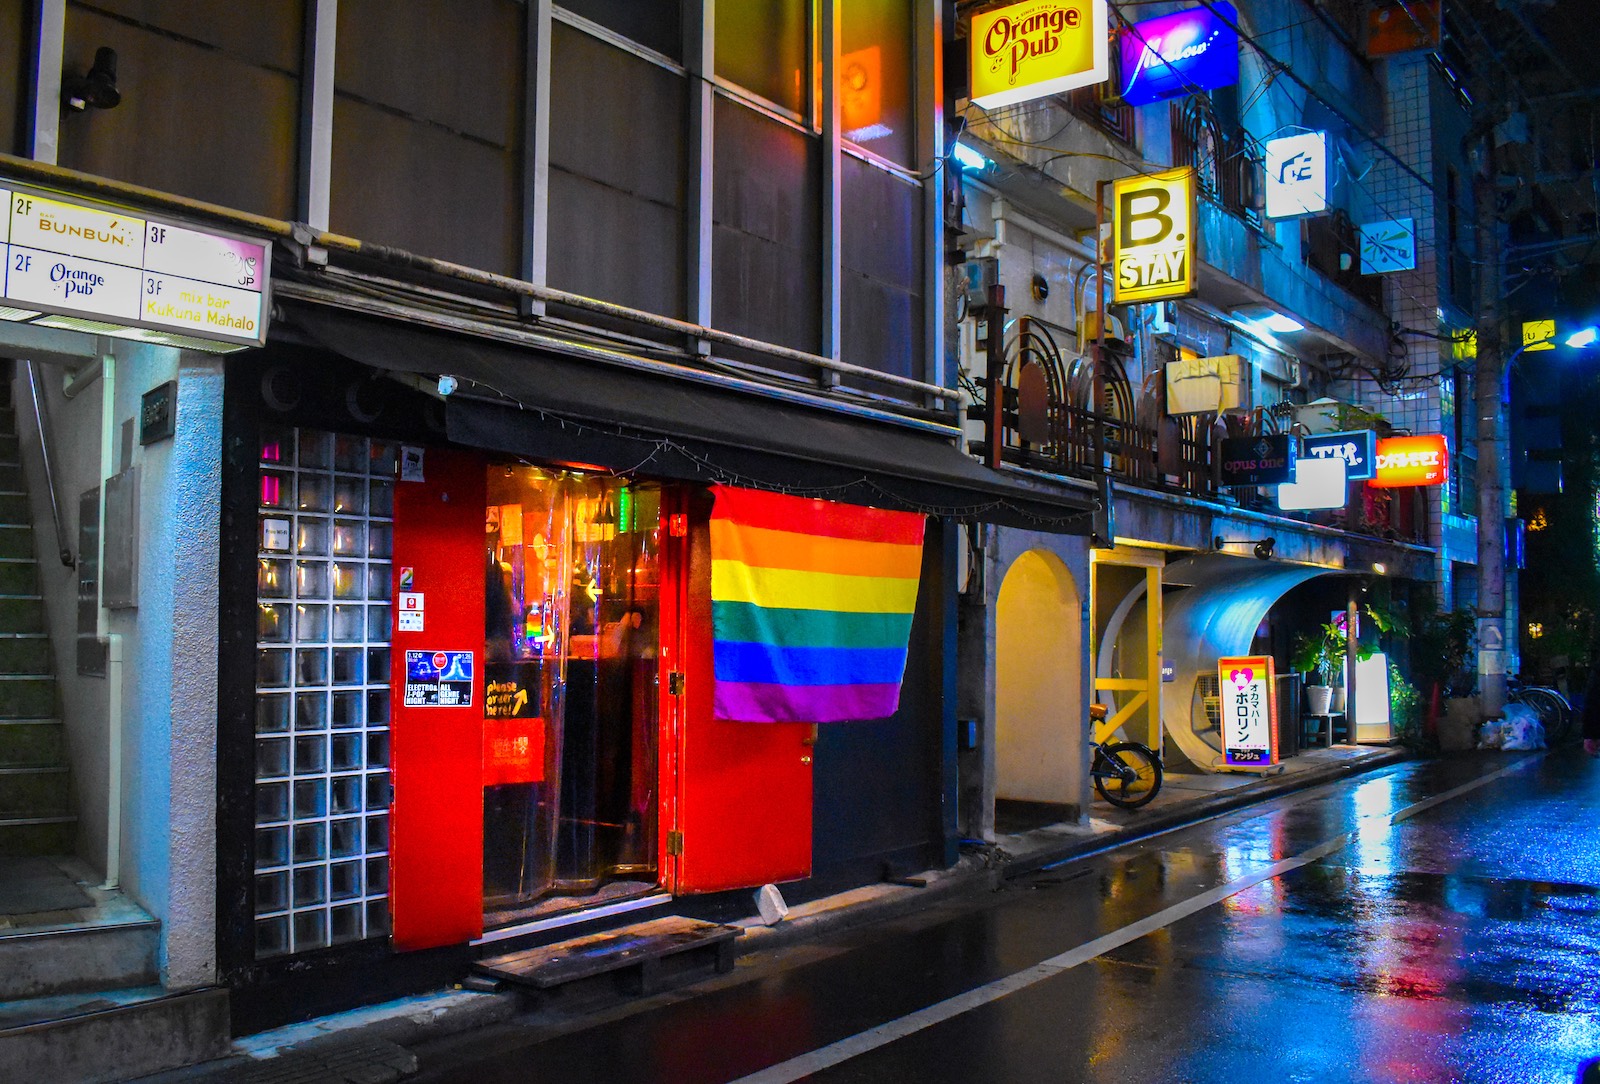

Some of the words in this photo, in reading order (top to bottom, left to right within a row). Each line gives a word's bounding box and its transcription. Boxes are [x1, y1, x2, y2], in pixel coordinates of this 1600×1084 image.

[985, 9, 1079, 56] Orange
[1011, 31, 1060, 75] Pub
[16, 198, 32, 216] 2F
[1120, 187, 1185, 250] B.
[151, 226, 166, 244] 3F
[15, 254, 32, 272] 2F
[1120, 250, 1185, 289] STAY
[50, 263, 105, 287] Orange
[65, 280, 93, 298] Pub
[147, 278, 162, 295] 3F
[180, 291, 203, 304] mix
[207, 294, 231, 309] bar
[207, 310, 255, 331] Mahalo
[1224, 459, 1257, 473] opus
[1259, 458, 1285, 469] one
[487, 679, 517, 696] please
[487, 694, 512, 705] order
[486, 704, 512, 716] here!
